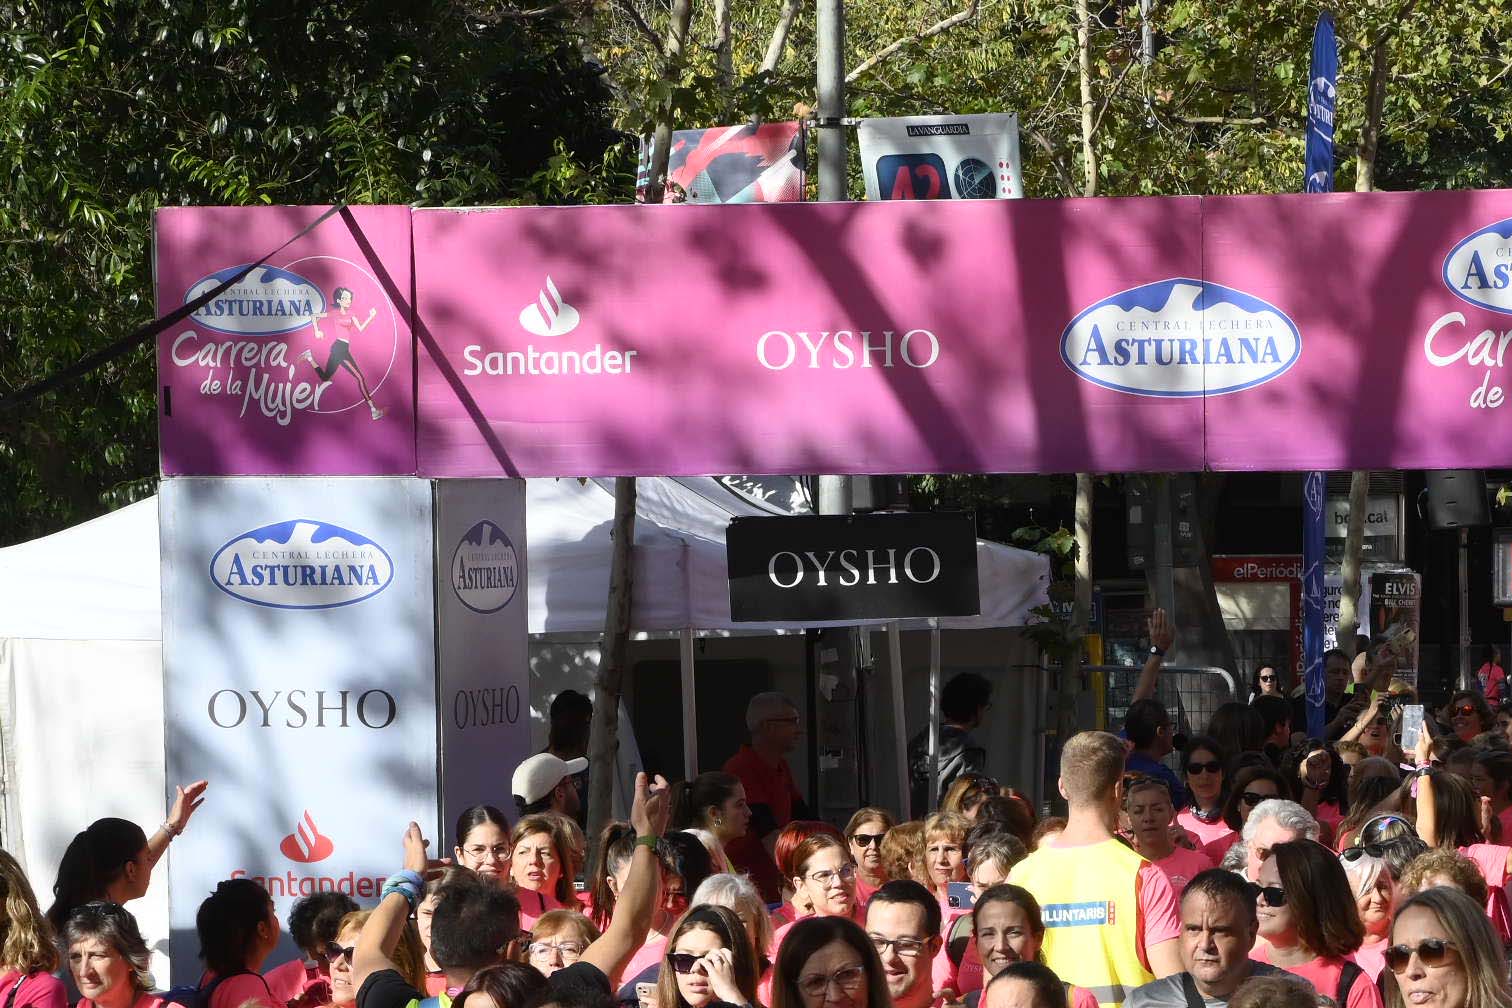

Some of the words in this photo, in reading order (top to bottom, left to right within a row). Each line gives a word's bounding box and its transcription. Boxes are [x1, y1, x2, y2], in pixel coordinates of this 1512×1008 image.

[196, 289, 314, 317] ASTURIANA
[1116, 319, 1192, 331] CENTRAL
[171, 330, 289, 367] Carrera
[463, 344, 637, 376] Santander
[756, 329, 941, 371] OYSHO
[1079, 323, 1282, 368] ASTURIANA
[200, 368, 222, 395] de
[226, 369, 242, 395] la
[240, 364, 333, 426] Mujer
[1469, 369, 1504, 409] de
[225, 552, 380, 587] ASTURIANA
[251, 551, 308, 560] CENTRAL
[315, 551, 374, 560] LECHERA
[456, 554, 518, 590] ASTURIANA
[767, 546, 942, 588] OYSHO
[1234, 561, 1303, 579] elPeriódi
[1385, 582, 1416, 595] ELVIS
[207, 688, 397, 729] OYSHO
[454, 684, 521, 731] OYSHO
